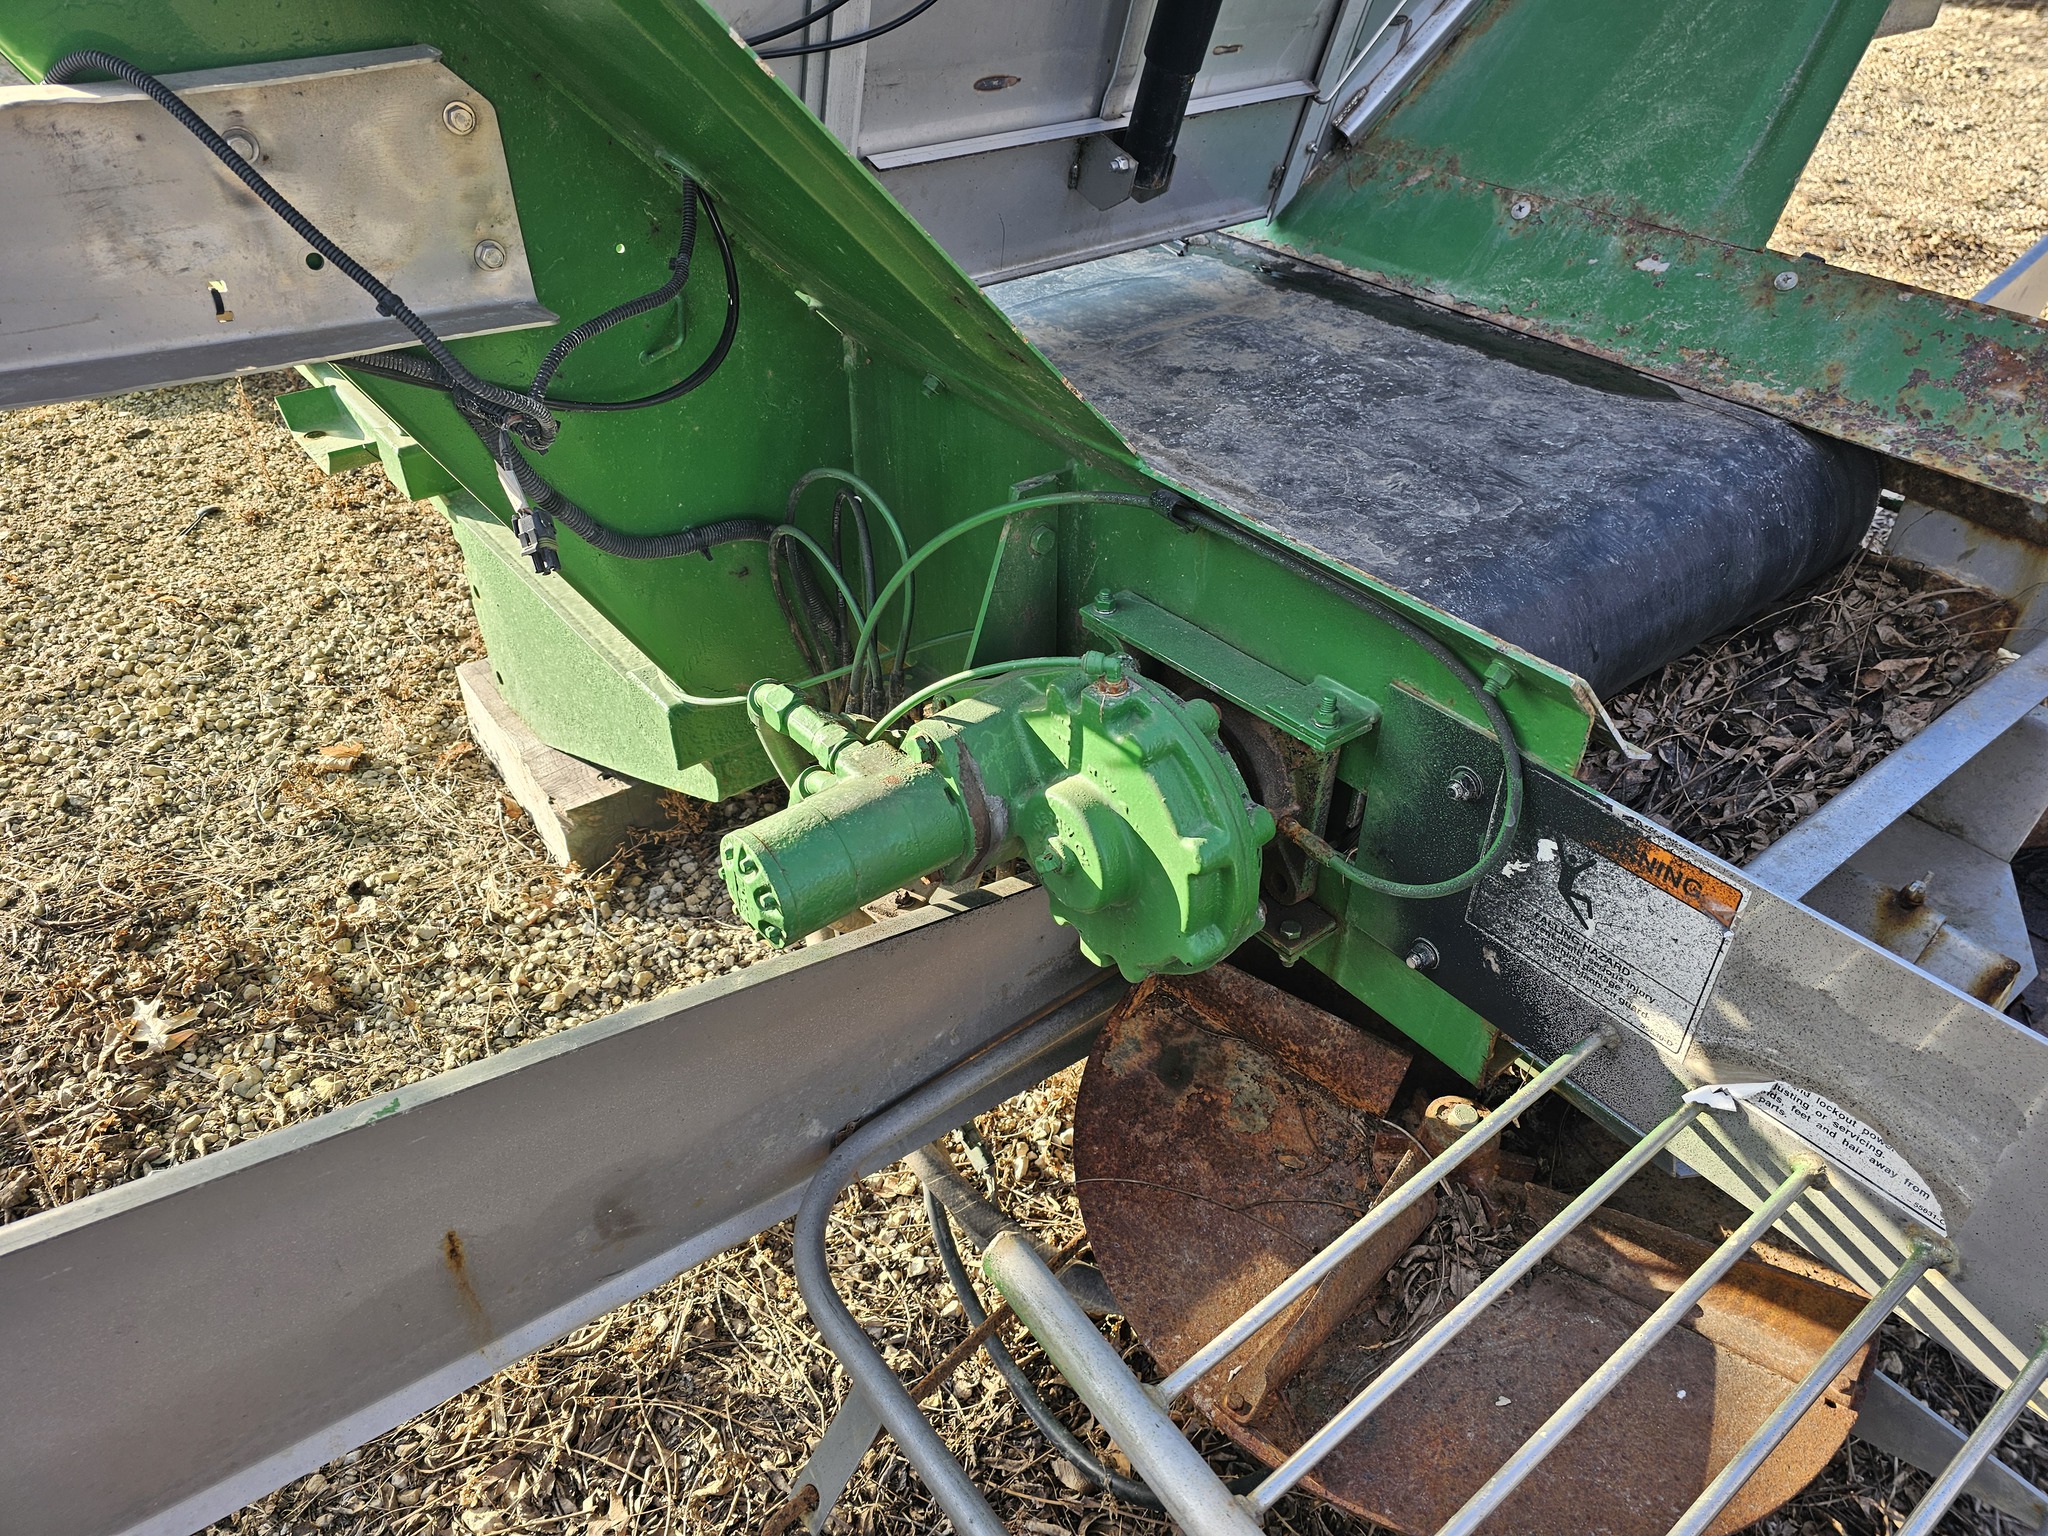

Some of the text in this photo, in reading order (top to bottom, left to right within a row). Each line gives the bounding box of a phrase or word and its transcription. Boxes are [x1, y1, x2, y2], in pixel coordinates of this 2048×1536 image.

[1535, 911, 1631, 976] FALLING HAZARD
[1542, 938, 1581, 965] machine
[1575, 968, 1601, 988] climb
[1618, 997, 1650, 1020] guard.
[1588, 958, 1624, 984] serious
[1626, 981, 1656, 1004] injury
[1758, 1096, 1787, 1118] parts.
[1771, 1082, 1886, 1159] justing or servicing.
[1815, 1097, 1857, 1128] lockout
[1791, 1105, 1811, 1122] feet
[1816, 1123, 1838, 1139] and
[1841, 1138, 1864, 1155] hair
[1868, 1157, 1898, 1178] away
[1903, 1178, 1930, 1199] from
